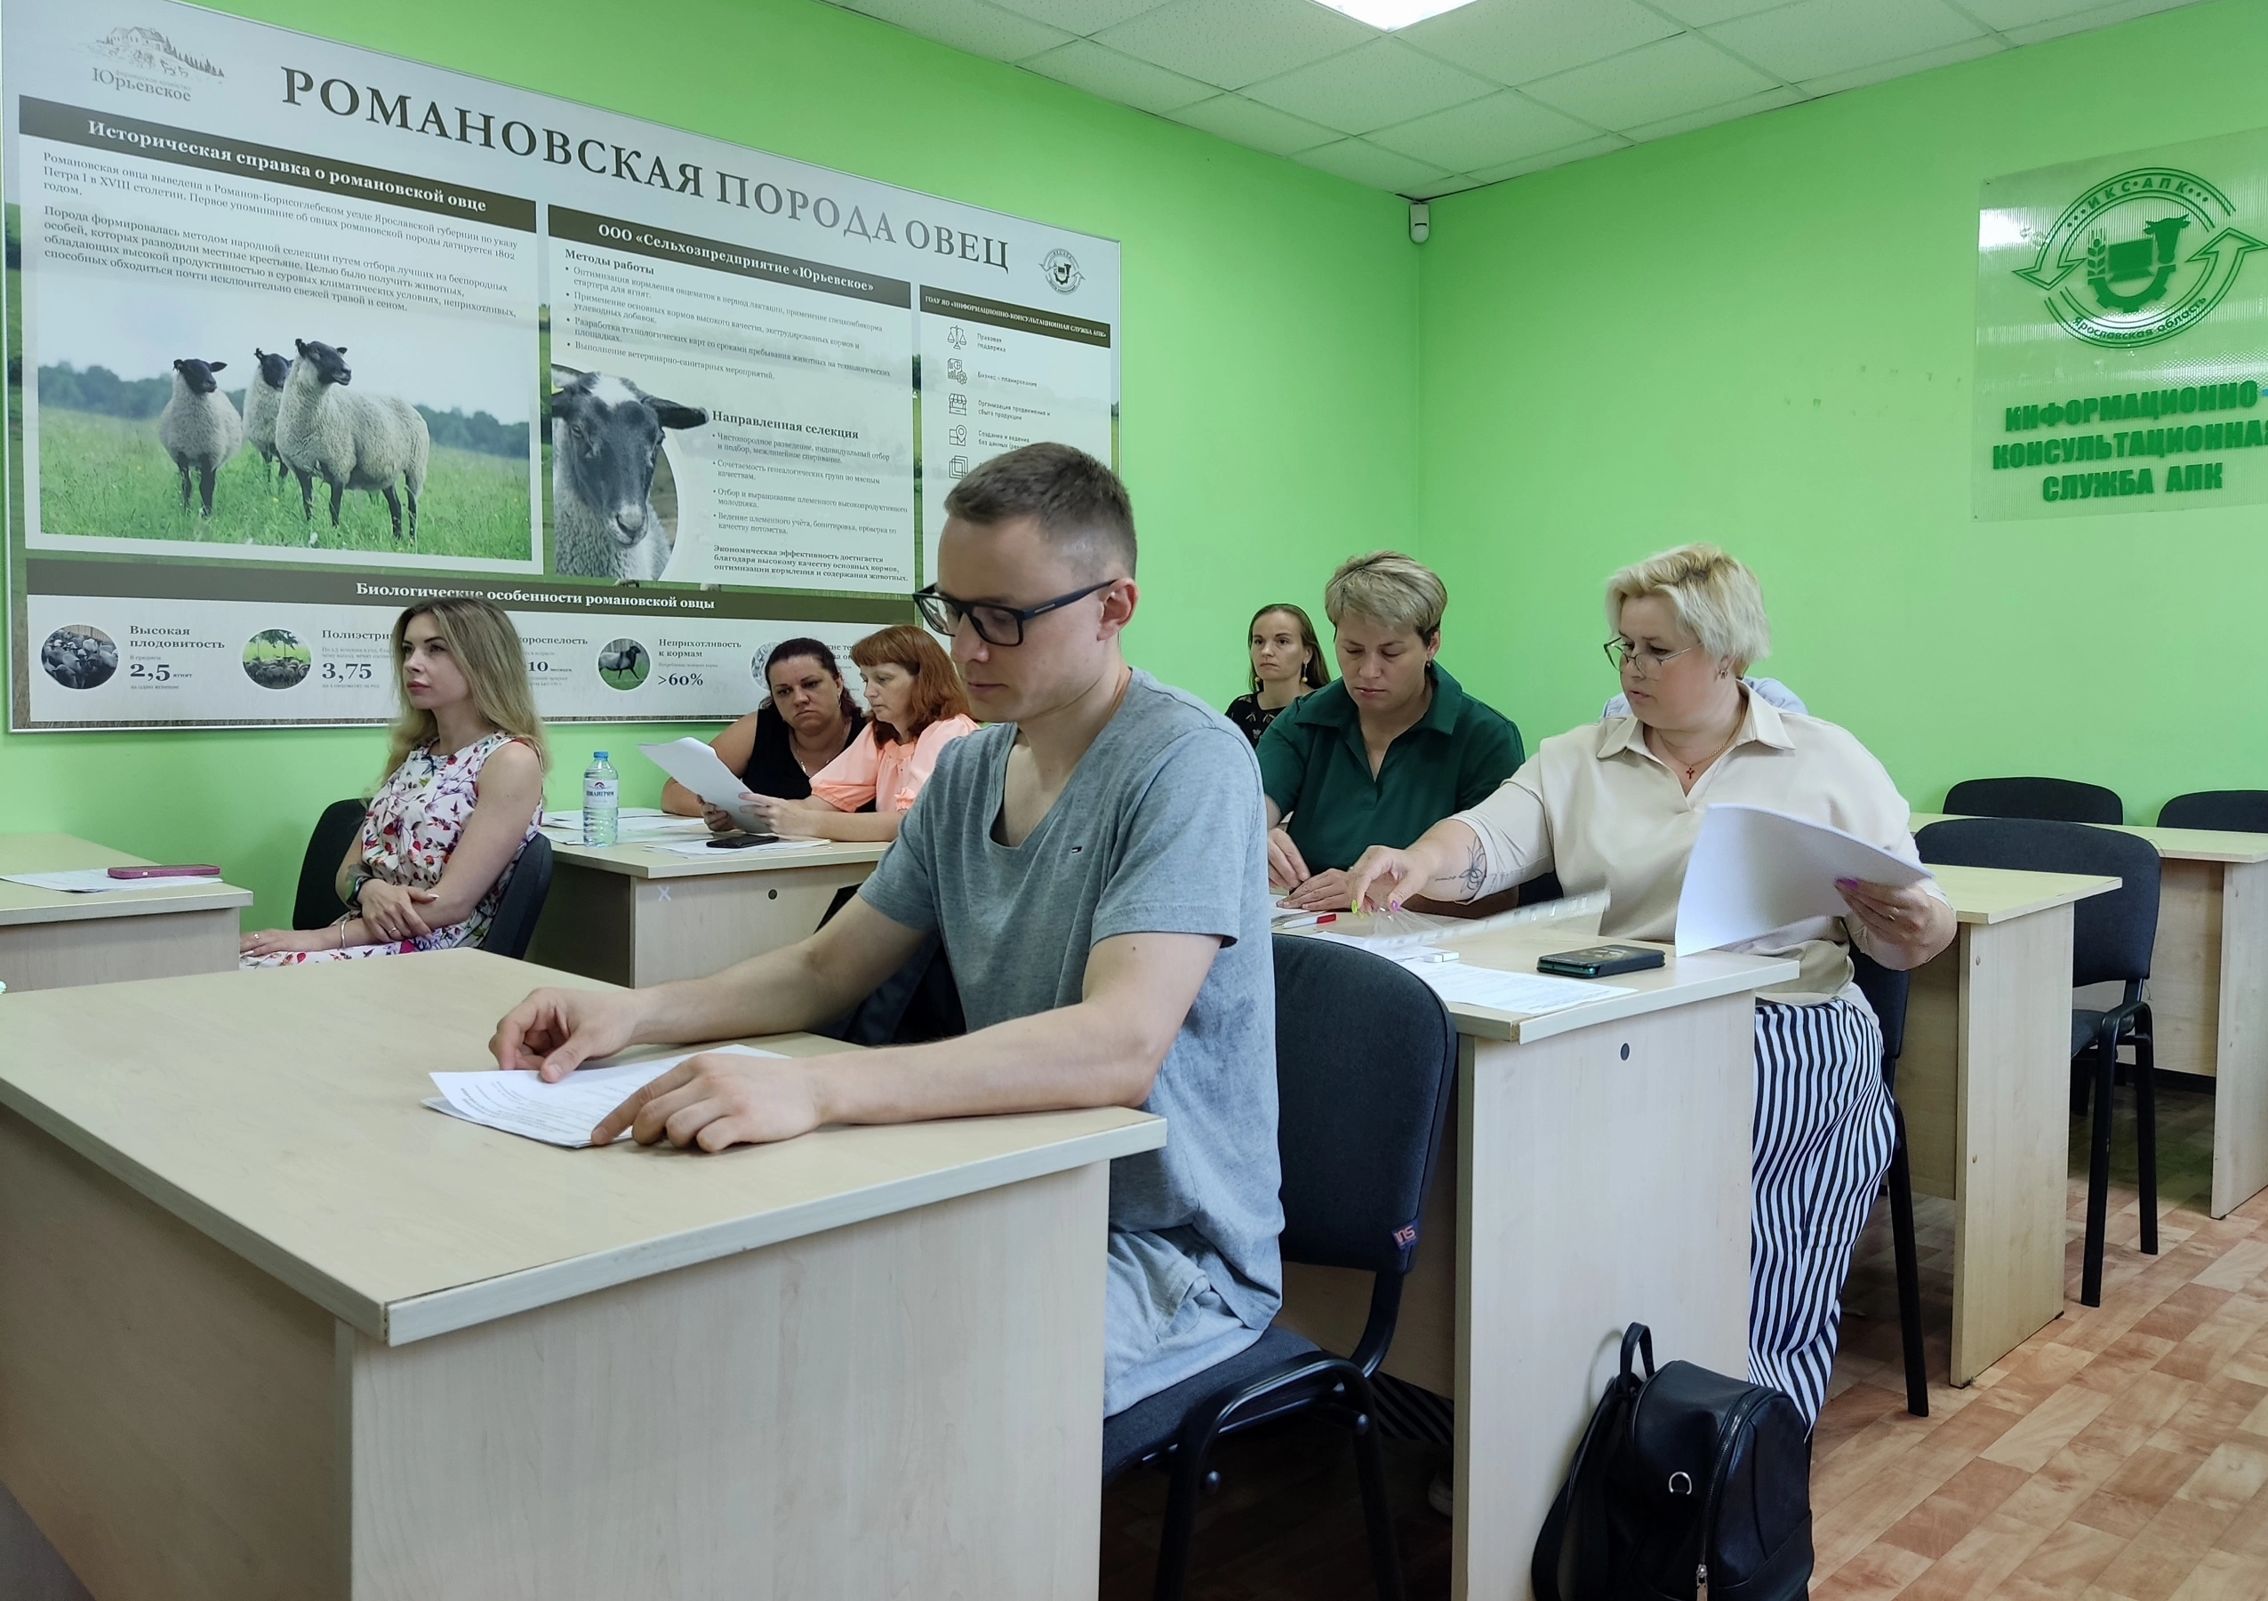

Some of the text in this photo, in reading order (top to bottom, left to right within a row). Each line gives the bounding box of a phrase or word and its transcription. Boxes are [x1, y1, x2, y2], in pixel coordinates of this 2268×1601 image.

[92, 67, 191, 102] Юрьевское
[89, 120, 485, 213] Историческая справка о романовской овце
[281, 66, 1009, 274] РОМАНОВСКАЯ ПОРОДА ОВЕЦ
[44, 182, 82, 195] годом.
[44, 205, 506, 291] Порода формировалась методом народной селекции путем отбора лучших из беспородных
[44, 222, 462, 298] особей, которых разводили местные крестьяне. Целью было получить животных,
[565, 248, 654, 275] Методы работы
[598, 224, 874, 292] ООО «Сельхозпредприятие «Юрьевское»
[44, 234, 515, 318] обладающих высокой продуктивностью в суровых климатических условиях, неприхотливых,
[44, 249, 407, 310] способных обходиться почти исключительно свежей травой и сеном.
[2072, 297, 2207, 340] Ярославская область
[2005, 380, 2258, 431] ИНФОРМАЦИОННО
[712, 410, 858, 440] Направленная селекция
[1993, 420, 2268, 469] КОНСУЛЬТАЦИОННА
[2043, 462, 2223, 502] СЛУЖБА АПК
[357, 582, 714, 611] Биологические особенности романовской овцы
[129, 625, 190, 636] Высокая
[129, 640, 225, 649] плодовитость
[322, 630, 391, 641] Полиэстри
[520, 637, 588, 645] ороспелость
[658, 638, 742, 648] Неприхотливость
[528, 661, 549, 672] 10
[666, 650, 703, 658] кормам
[130, 663, 171, 681] 2,5
[322, 663, 372, 682] 3,75
[658, 673, 704, 686] >60%
